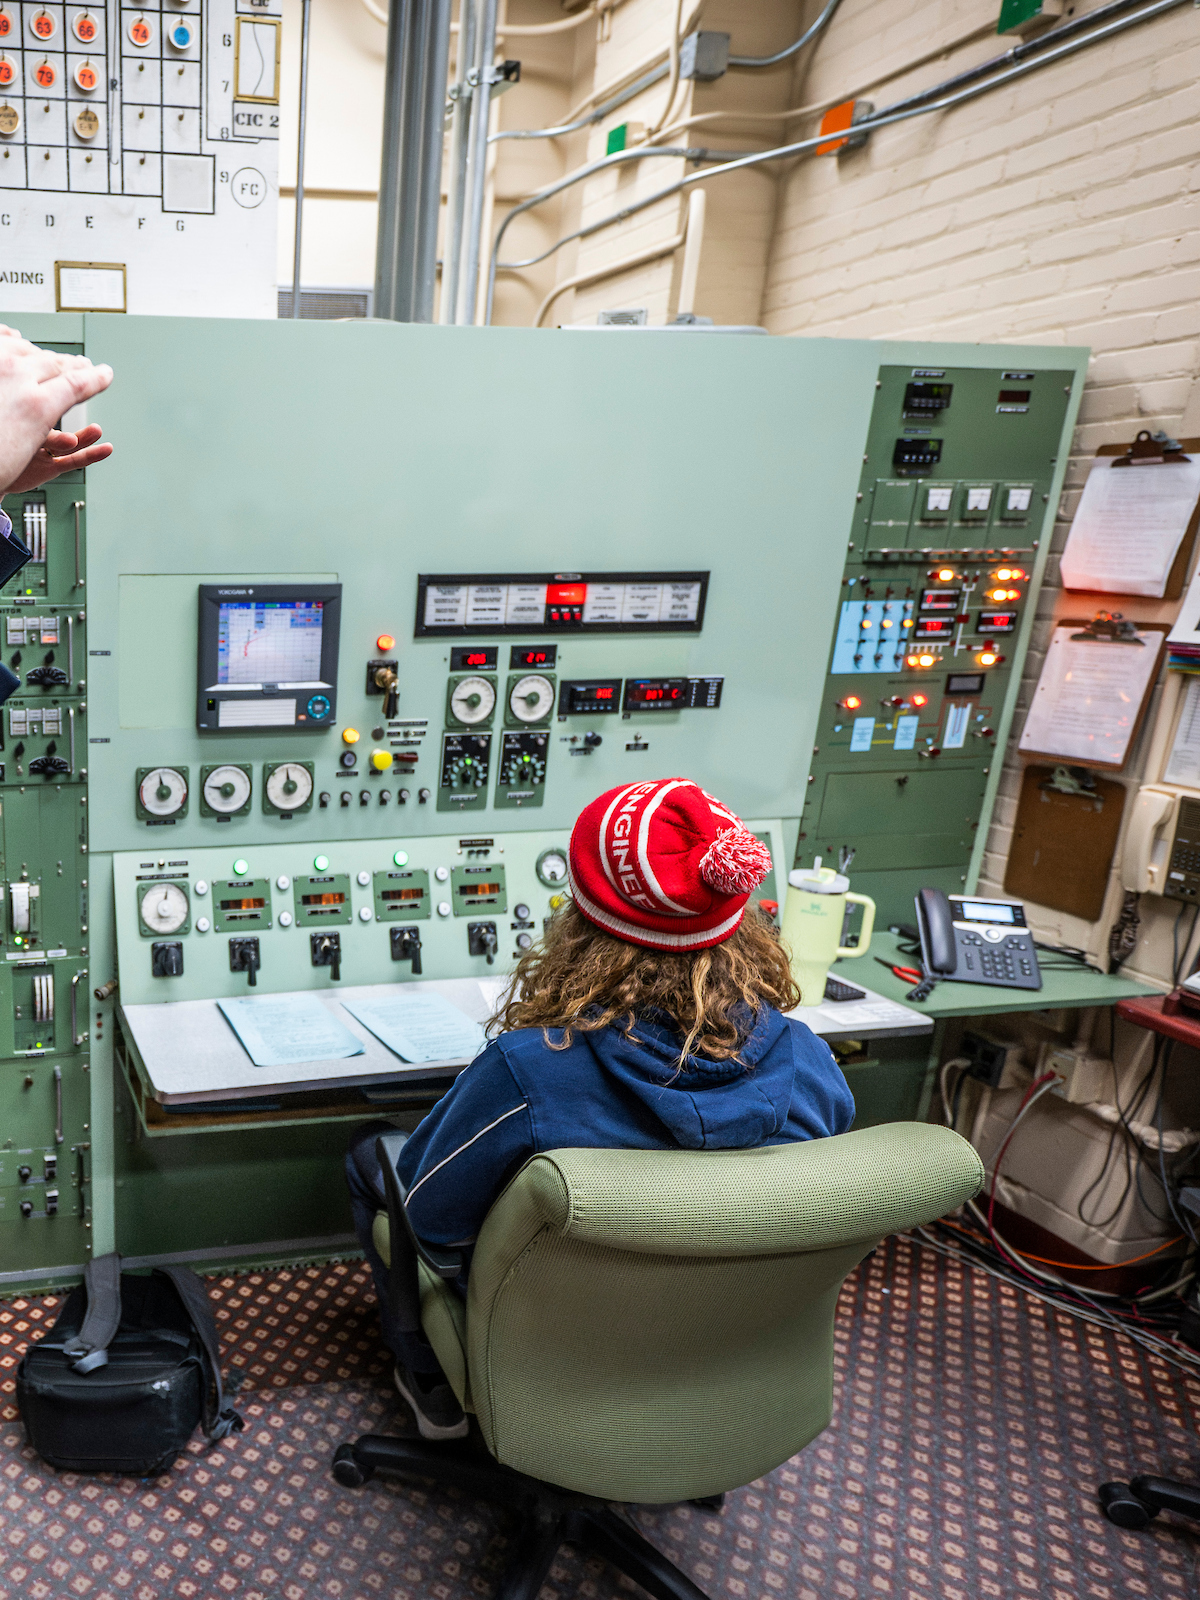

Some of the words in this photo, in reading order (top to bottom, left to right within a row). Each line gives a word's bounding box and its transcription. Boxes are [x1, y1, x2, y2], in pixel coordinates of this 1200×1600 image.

[36, 22, 51, 34] 63
[79, 25, 94, 37] 66
[133, 28, 148, 40] 74
[223, 34, 231, 47] 6
[38, 70, 53, 83] 79
[80, 73, 93, 85] 71
[222, 80, 230, 93] 7
[235, 113, 263, 127] CIC
[270, 115, 279, 128] 2
[220, 127, 229, 140] 8
[220, 171, 229, 183] 9
[1, 213, 10, 226] C
[46, 214, 55, 227] D
[85, 216, 93, 229] E
[138, 218, 146, 230] F
[176, 220, 185, 232] G
